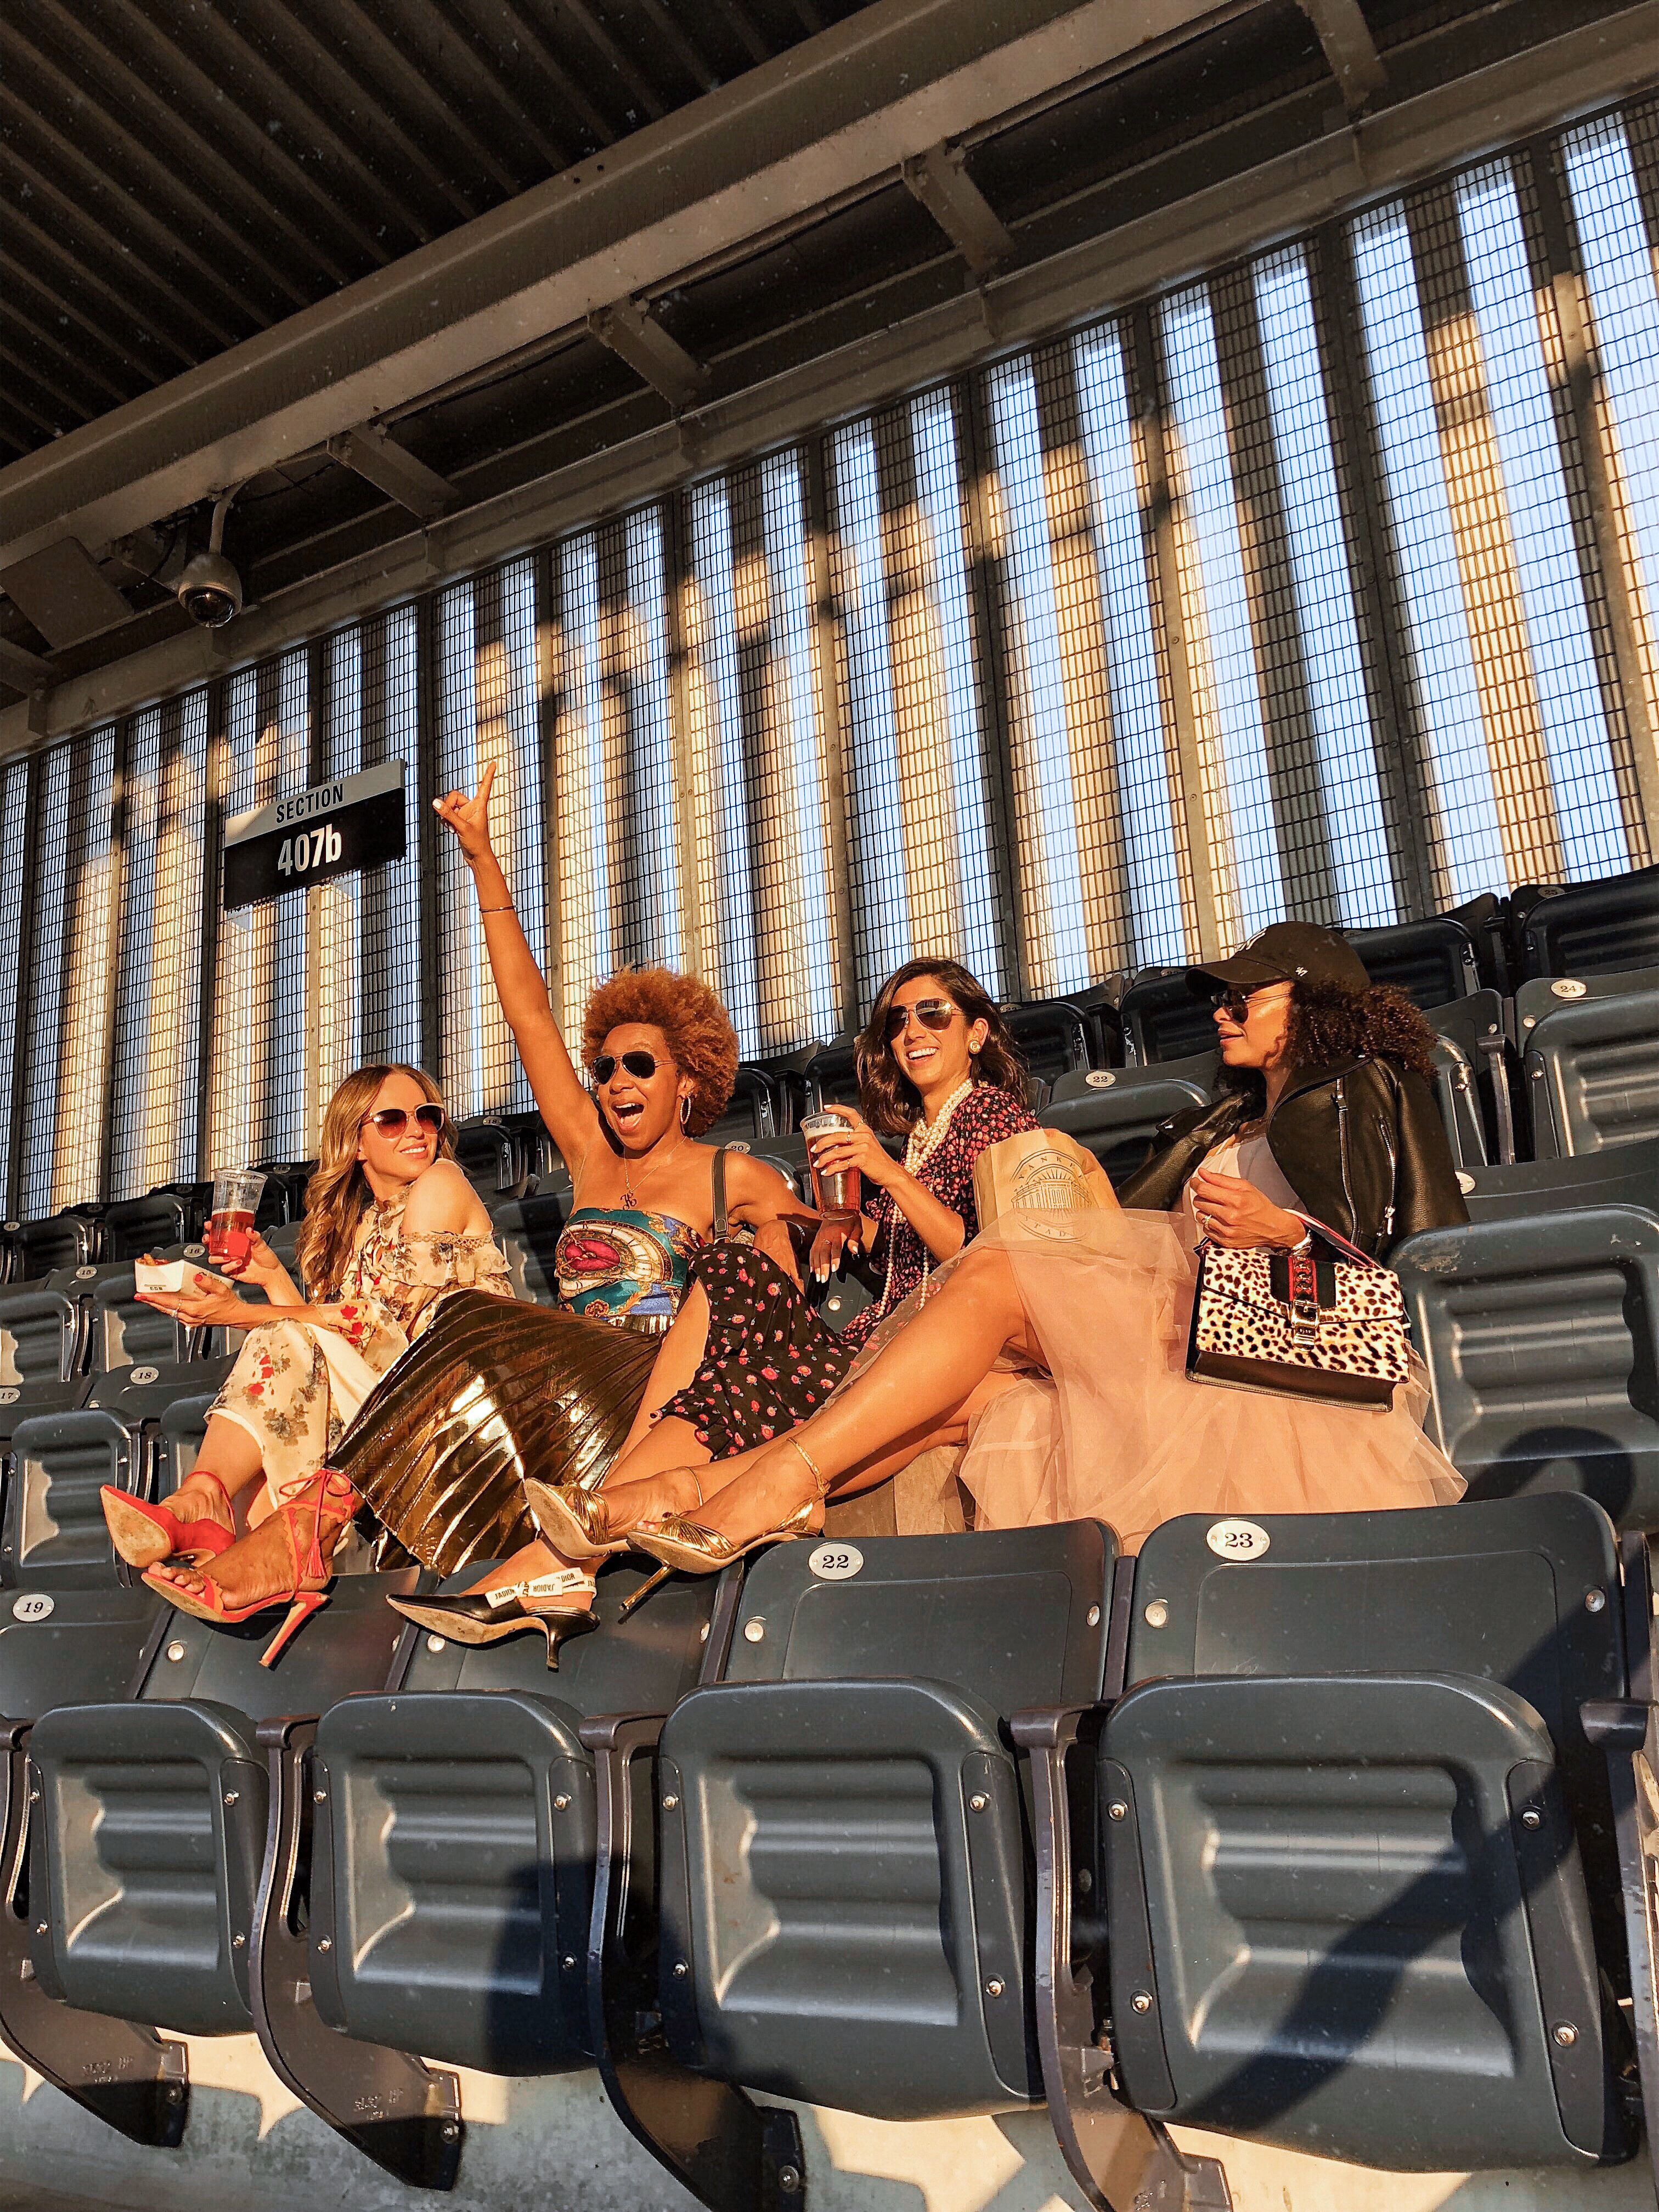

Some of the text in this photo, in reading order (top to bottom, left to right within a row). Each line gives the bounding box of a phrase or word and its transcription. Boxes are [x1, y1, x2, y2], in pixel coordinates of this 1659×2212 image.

[276, 783, 344, 823] SECTION
[278, 823, 342, 876] 407b
[1225, 1532, 1253, 1548] 23
[822, 1554, 849, 1569] 22
[24, 1601, 44, 1613] 19
